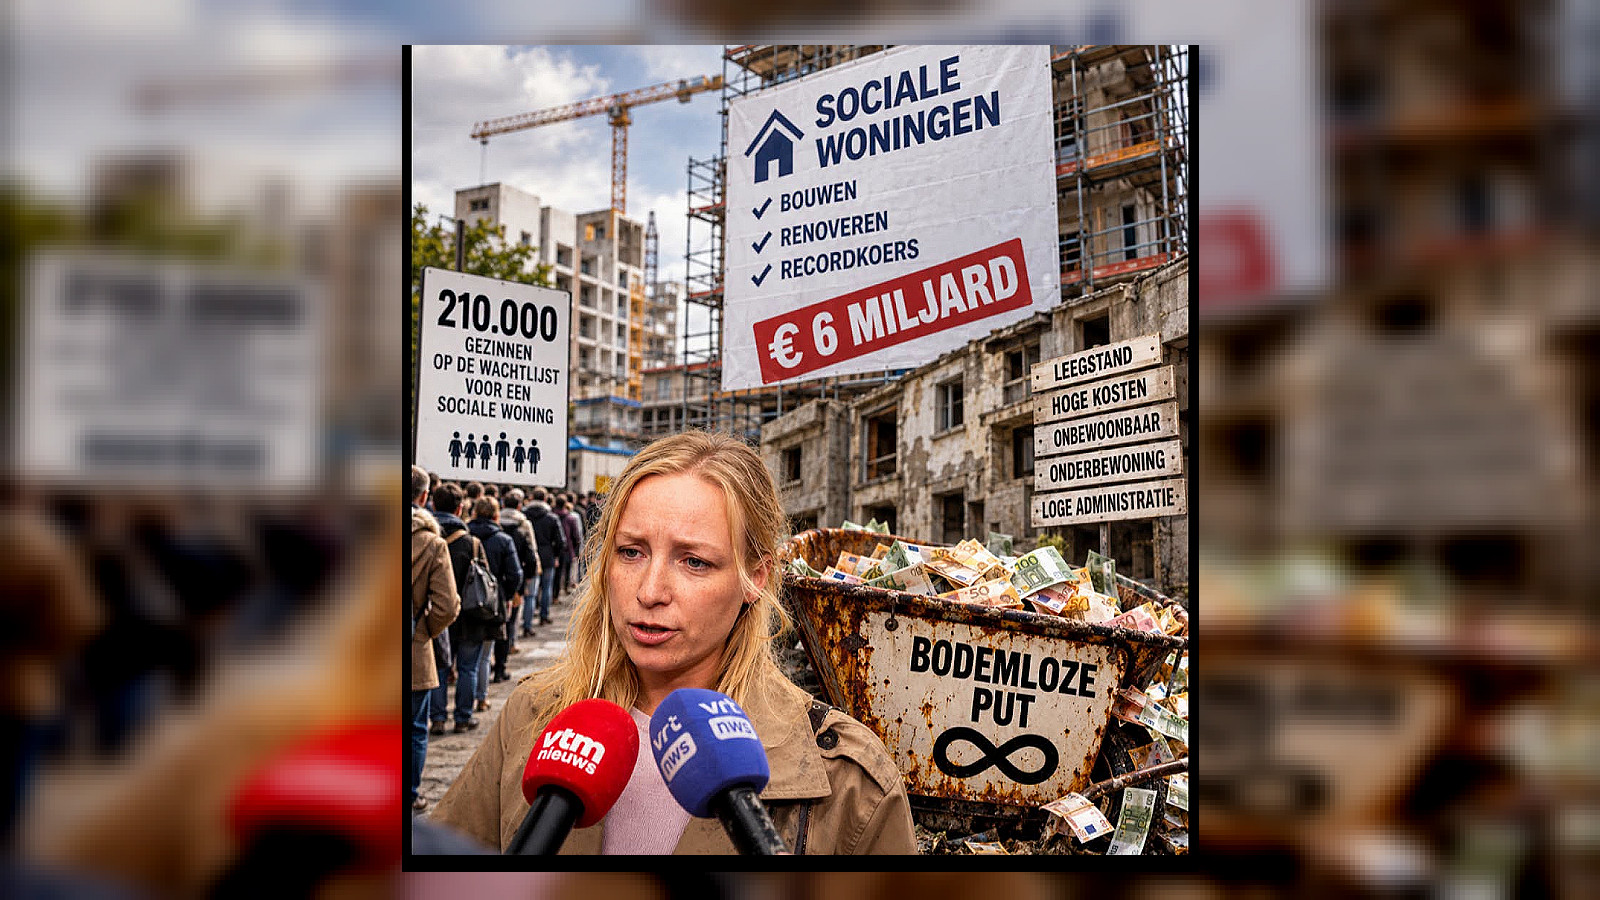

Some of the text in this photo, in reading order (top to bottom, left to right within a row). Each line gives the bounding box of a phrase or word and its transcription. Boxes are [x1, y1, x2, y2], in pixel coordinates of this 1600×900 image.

[815, 55, 961, 129] SOCIALE
[815, 90, 1001, 168] WONINGEN
[781, 180, 857, 212] BOUWEN
[781, 211, 889, 247] RENOVEREN
[781, 239, 919, 280] RECORDKOERS
[437, 288, 558, 342] 210.000
[768, 255, 1020, 369] € 6 MILJARD
[465, 337, 532, 361] GEZINNEN
[1054, 345, 1133, 381] LEEGSTAND
[433, 353, 560, 385] OP DE WACHTLIJST
[465, 378, 531, 401] VOOR EEN
[1052, 377, 1147, 415] HOGE KOSTEN
[437, 396, 554, 424] SOCIALE WONING
[1053, 412, 1161, 447] ONBEWOONBAAR
[1050, 449, 1166, 482] ONDERBEWONING
[1042, 487, 1175, 519] LOGE ADMINISTRATIE
[910, 635, 1098, 698] BODEMLOZE
[699, 697, 743, 716] vrt
[971, 687, 1036, 728] PUT
[652, 714, 683, 751] vrt
[717, 719, 752, 735] nws
[537, 747, 597, 776] nieuws
[542, 728, 606, 765] vtm
[664, 741, 690, 776] nws
